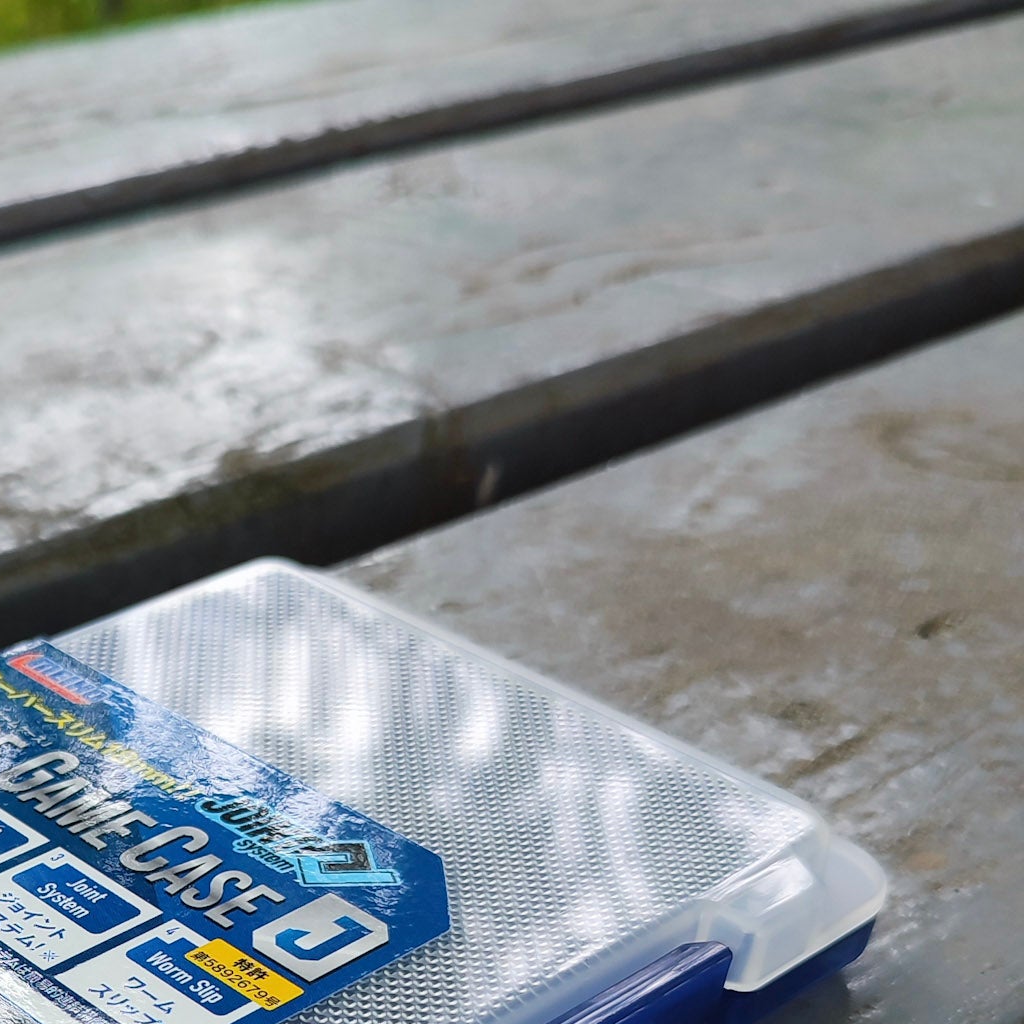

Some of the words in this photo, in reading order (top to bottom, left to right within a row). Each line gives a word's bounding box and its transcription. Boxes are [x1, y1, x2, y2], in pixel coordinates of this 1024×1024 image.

[230, 837, 296, 874] system
[62, 875, 112, 904] Joint
[116, 825, 288, 928] CASE
[28, 880, 98, 921] System
[141, 950, 201, 985] Worm
[181, 978, 232, 1007] Slip
[188, 949, 284, 1008] 第5892679号
[229, 957, 272, 982] 特許
[119, 975, 183, 1015] ワーム
